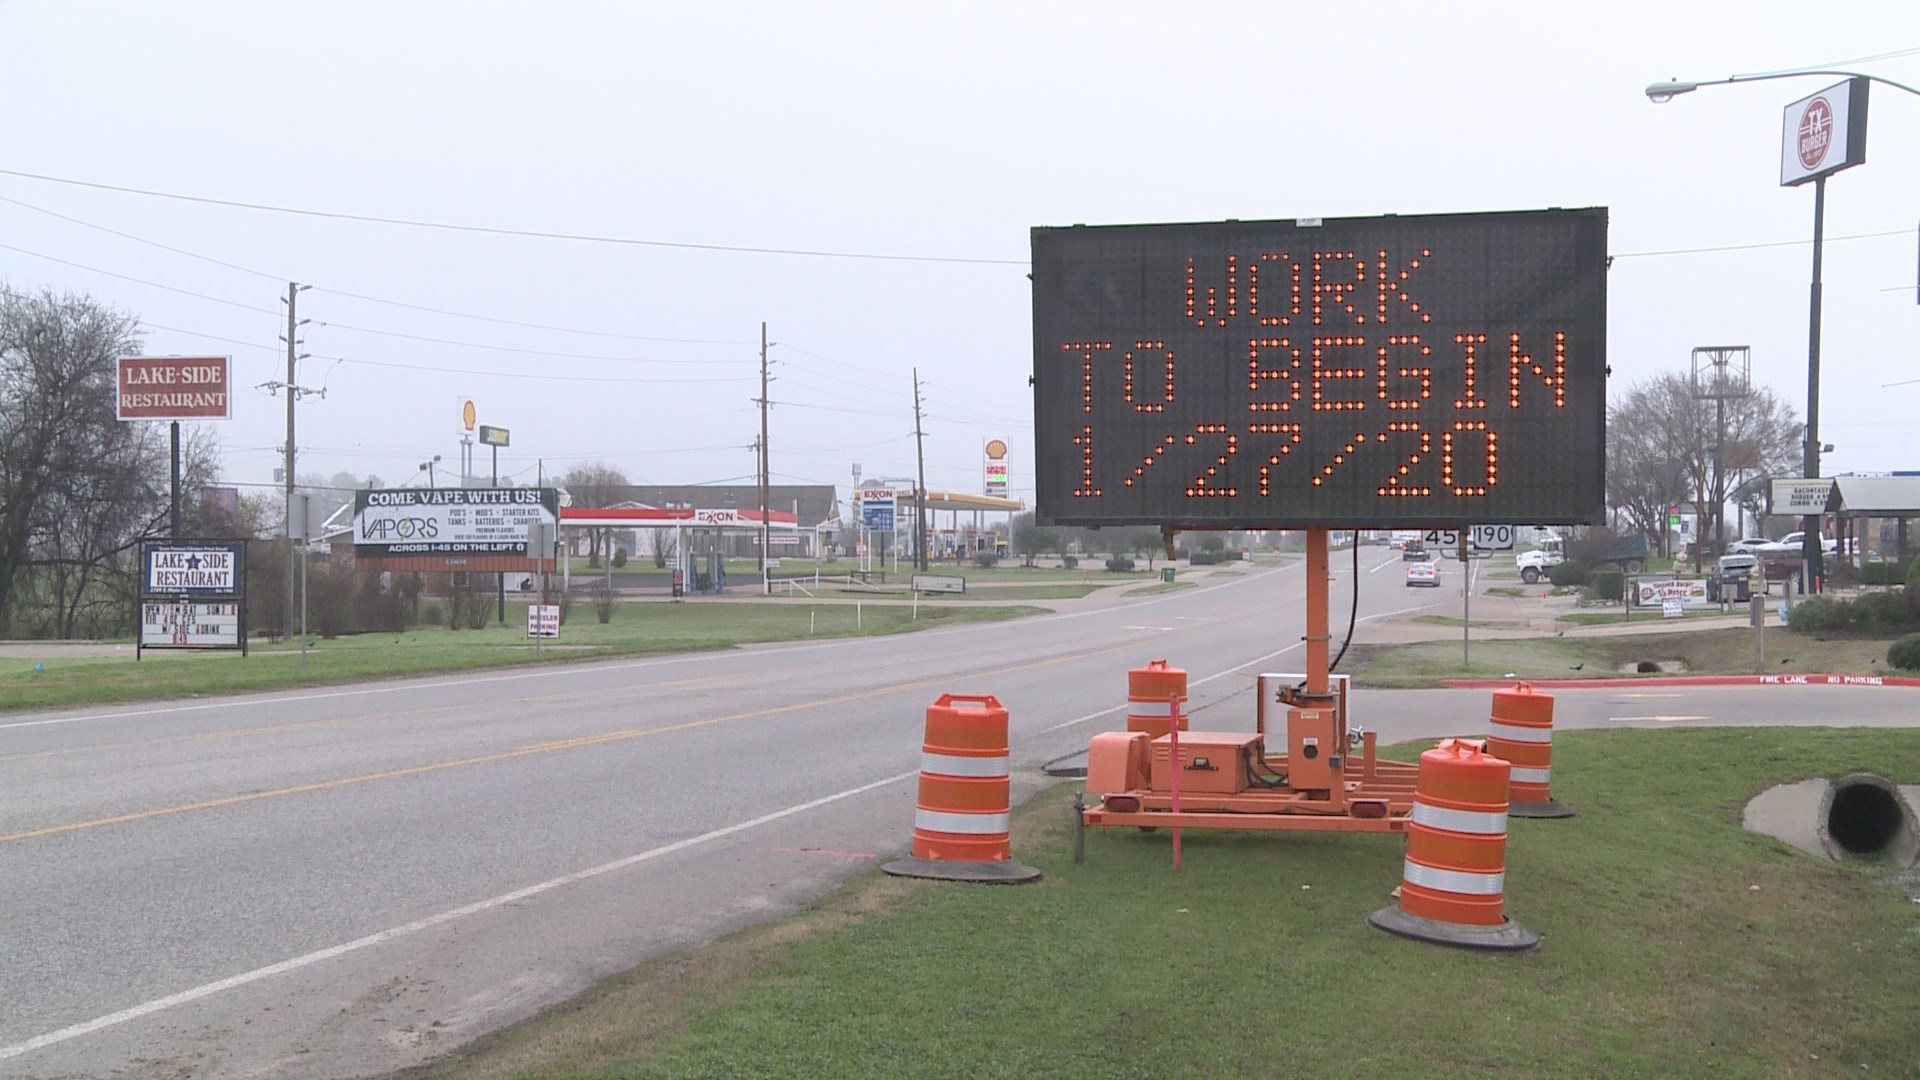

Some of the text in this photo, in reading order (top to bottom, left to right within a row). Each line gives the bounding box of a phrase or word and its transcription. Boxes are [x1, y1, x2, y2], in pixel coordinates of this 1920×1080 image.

[1808, 107, 1823, 135] TX
[1801, 131, 1828, 154] BURGER
[1186, 247, 1431, 327] WORK
[126, 366, 221, 384] LAKE-SIDE
[1063, 331, 1564, 413] TO BEGIN
[122, 392, 225, 408] RESTAURANT
[1073, 420, 1497, 497] 1/27/20
[368, 490, 541, 505] COME VAPE WITH US!
[864, 489, 893, 500] EXXON
[502, 508, 526, 517] STARTER
[527, 508, 540, 516] KITS
[698, 511, 734, 524] EXXON
[362, 510, 439, 539] VAPORS
[447, 518, 466, 526] TANKS
[474, 518, 504, 526] BATTERIES
[1425, 530, 1456, 545] 45
[1477, 526, 1509, 543] 190
[388, 543, 514, 553] ACROSS I-45 ON THE LEFT
[155, 553, 184, 568] LAKE
[202, 553, 229, 569] SIDE
[156, 571, 229, 586] RESTAURANT
[145, 604, 160, 615] OPEN
[174, 624, 190, 634] SIDE
[1759, 675, 1883, 685] FIRE LANE NO PARKING
